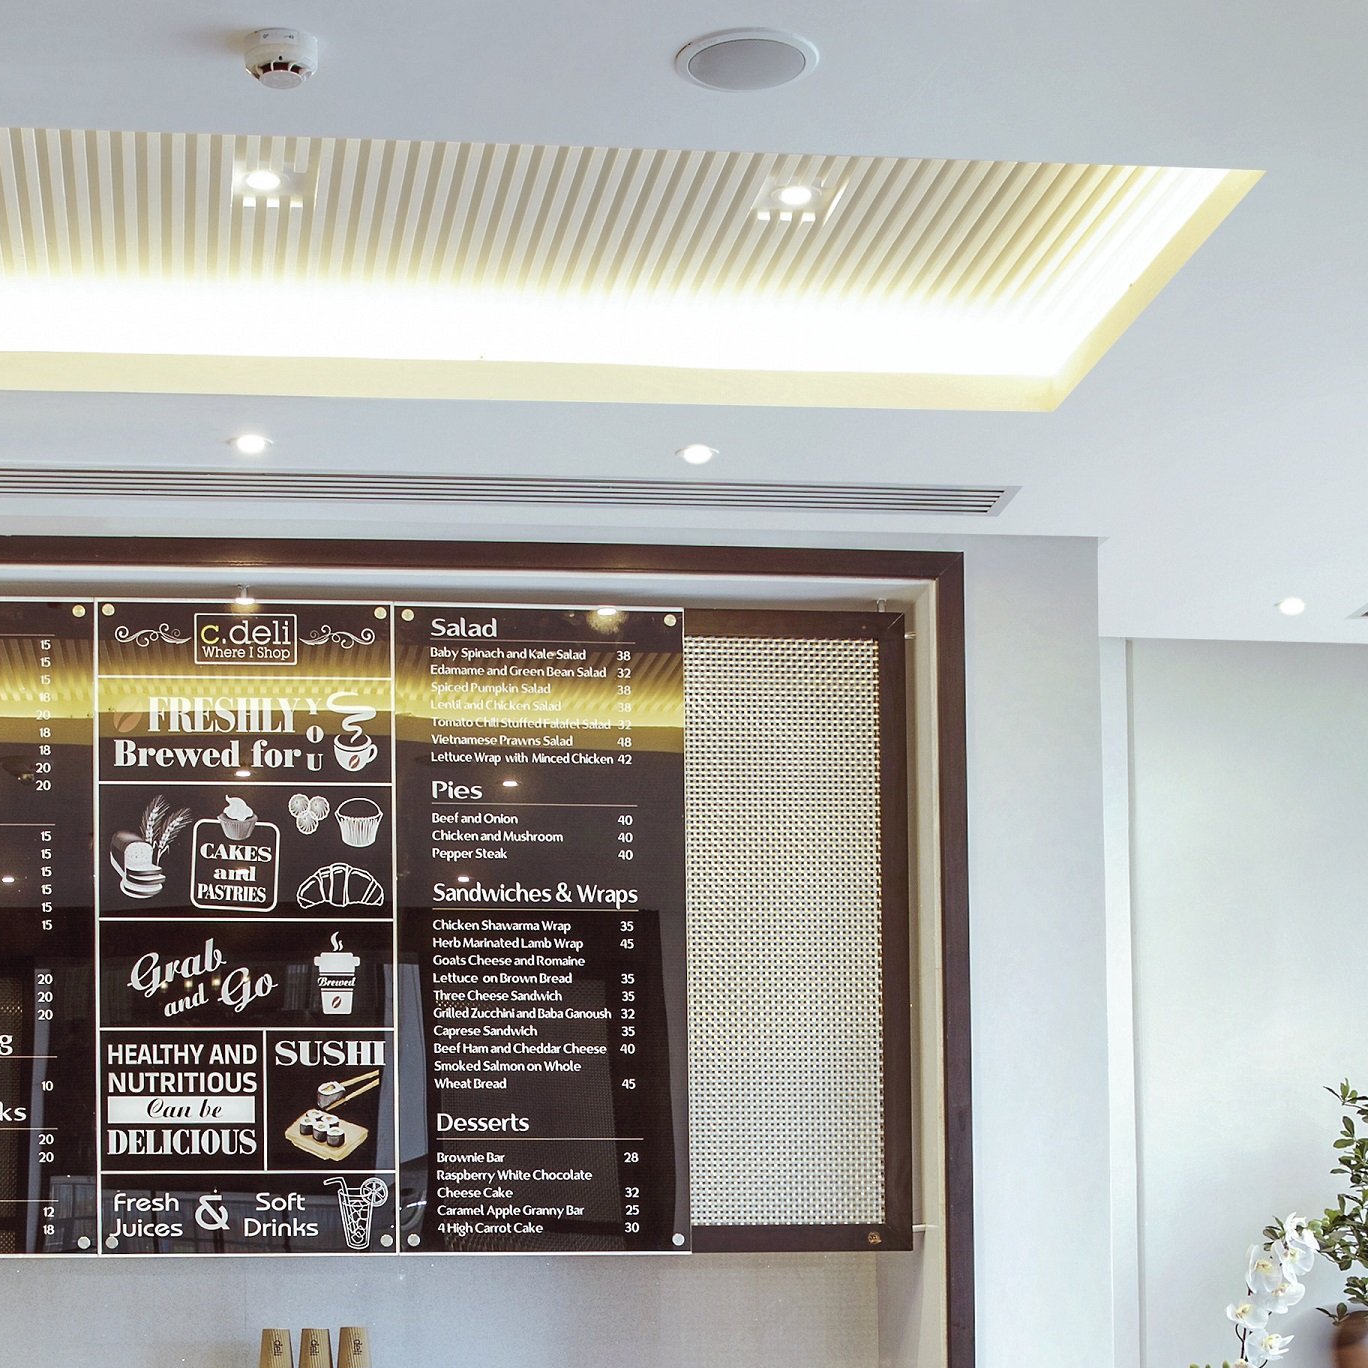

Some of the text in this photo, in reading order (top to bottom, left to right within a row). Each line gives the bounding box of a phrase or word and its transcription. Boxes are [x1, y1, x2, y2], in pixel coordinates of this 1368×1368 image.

[201, 620, 290, 645] c.deli
[431, 618, 497, 638] Salad
[40, 640, 50, 650] 15
[202, 646, 290, 660] Where I Shop
[431, 666, 631, 678] Edamame and Green Bean Salad 32
[148, 697, 298, 732] FRESHLY
[40, 728, 50, 738] 18
[114, 740, 301, 768] Brewed for
[431, 752, 632, 766] Lettuce Wrap with Minced Chicken 42
[36, 764, 51, 773] 20
[36, 781, 51, 790] 20
[432, 781, 482, 800] Pies
[41, 832, 51, 841] 15
[432, 830, 632, 842] Chicken and Mushroom 40
[200, 843, 272, 862] CAKES
[214, 866, 255, 882] and
[198, 884, 266, 902] PASTRIES
[433, 882, 638, 910] Sandwiches & Wraps
[42, 921, 52, 930] 15
[433, 920, 634, 934] Chicken Shawarma Wrap 35
[127, 938, 226, 998] Grab
[318, 976, 356, 987] Brewed
[165, 967, 278, 1017] and Go
[38, 1010, 53, 1020] 20
[434, 1008, 635, 1020] Grilled Zucchini and Baba Ganoush 32
[108, 1044, 257, 1064] HEALTHY AND
[275, 1041, 386, 1066] SUSHI
[434, 1061, 581, 1072] Smoked Salmon on Whole
[42, 1082, 53, 1091] 10
[108, 1072, 257, 1093] NUTRITIOUS
[435, 1078, 636, 1090] Wheat Bread 45
[147, 1098, 223, 1119] Can be
[437, 1113, 529, 1132] Desserts
[107, 1129, 256, 1154] DELICIOUS
[39, 1153, 54, 1162] 20
[437, 1152, 638, 1163] Brownie Bar 28
[114, 1192, 179, 1212] Fresh
[256, 1193, 305, 1211] Soft
[195, 1195, 230, 1230] &
[437, 1205, 639, 1219] Caramel Apple Granny Bar 25
[43, 1225, 54, 1235] 18
[110, 1218, 183, 1237] Juices
[244, 1217, 318, 1236] Drinks
[438, 1223, 639, 1237] 4 High Carrot Cake 30
